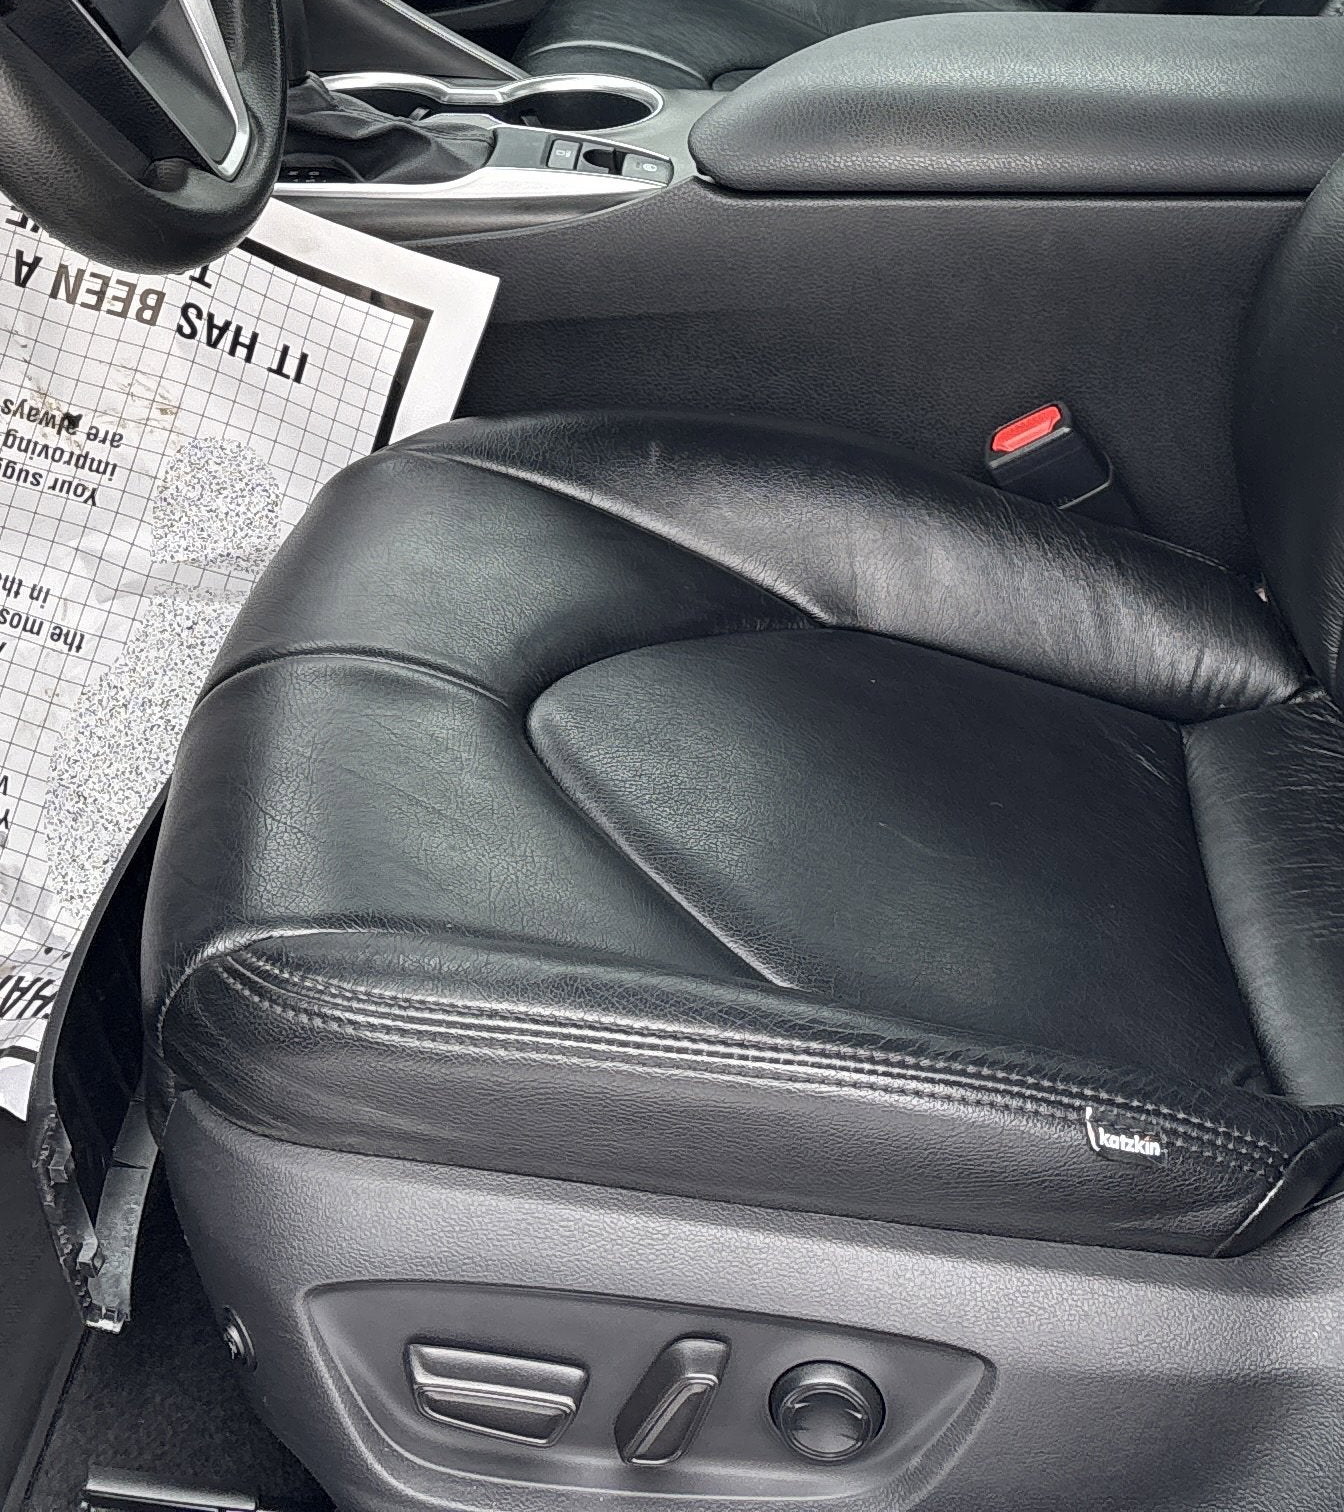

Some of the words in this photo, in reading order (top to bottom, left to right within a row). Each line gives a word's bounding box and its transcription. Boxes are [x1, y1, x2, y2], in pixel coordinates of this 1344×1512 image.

[14, 248, 43, 289] A
[49, 263, 167, 327] BEEN
[175, 301, 259, 365] HAS
[266, 342, 309, 385] IT
[4, 427, 118, 482] improving
[86, 424, 124, 449] are
[47, 476, 97, 507] Your
[29, 583, 51, 609] in
[50, 625, 86, 655] the
[1098, 1127, 1161, 1158] katzkin
